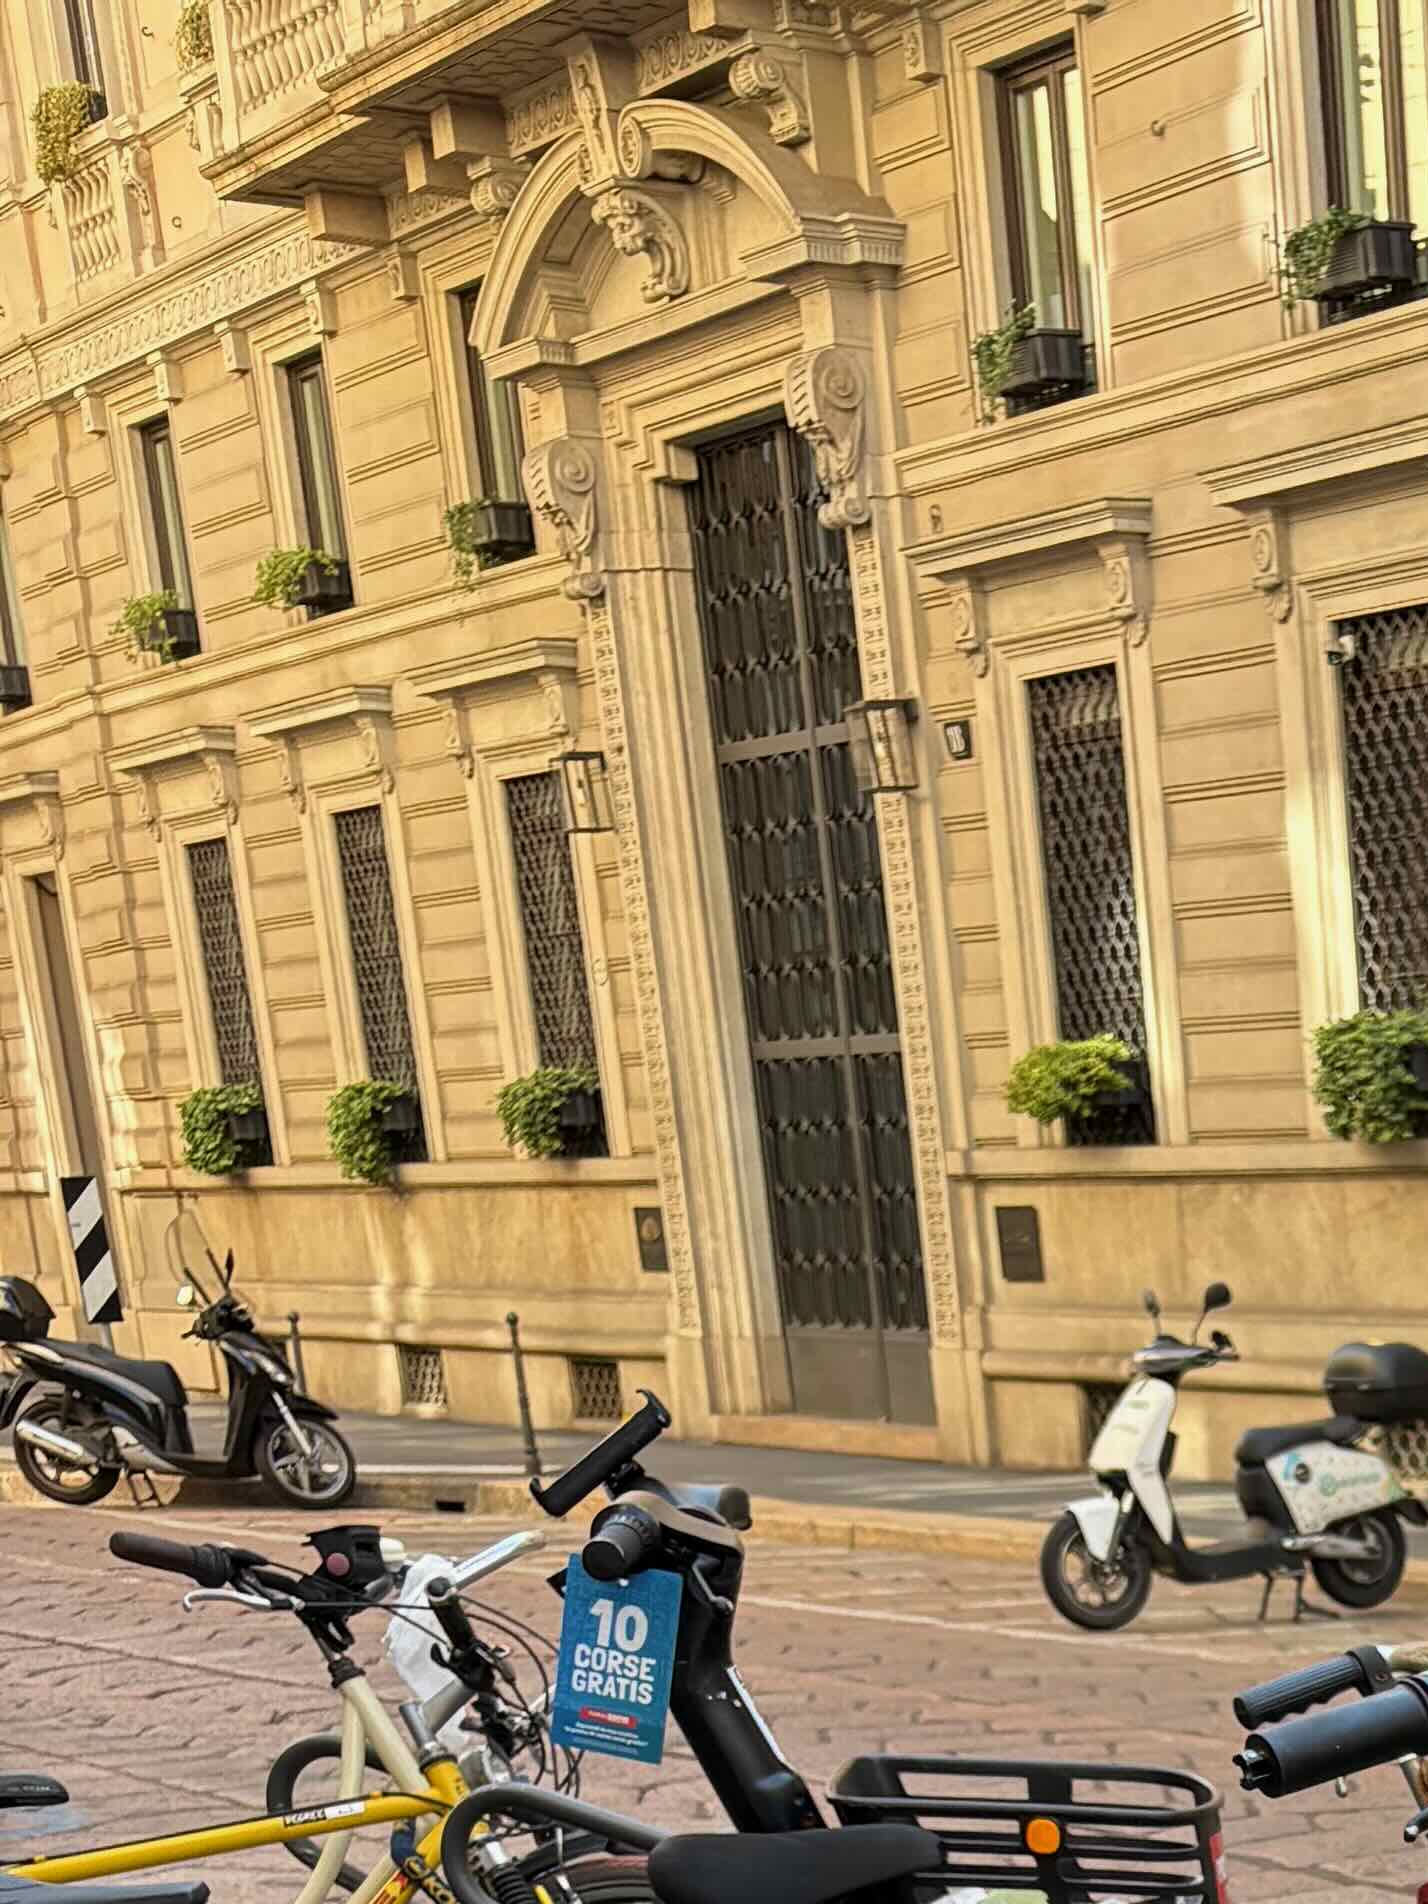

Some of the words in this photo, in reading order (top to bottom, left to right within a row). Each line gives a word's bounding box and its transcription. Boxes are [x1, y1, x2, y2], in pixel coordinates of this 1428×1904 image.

[589, 1598, 649, 1653] 10
[573, 1643, 657, 1682] CORSE
[571, 1669, 655, 1705] GRATIS
